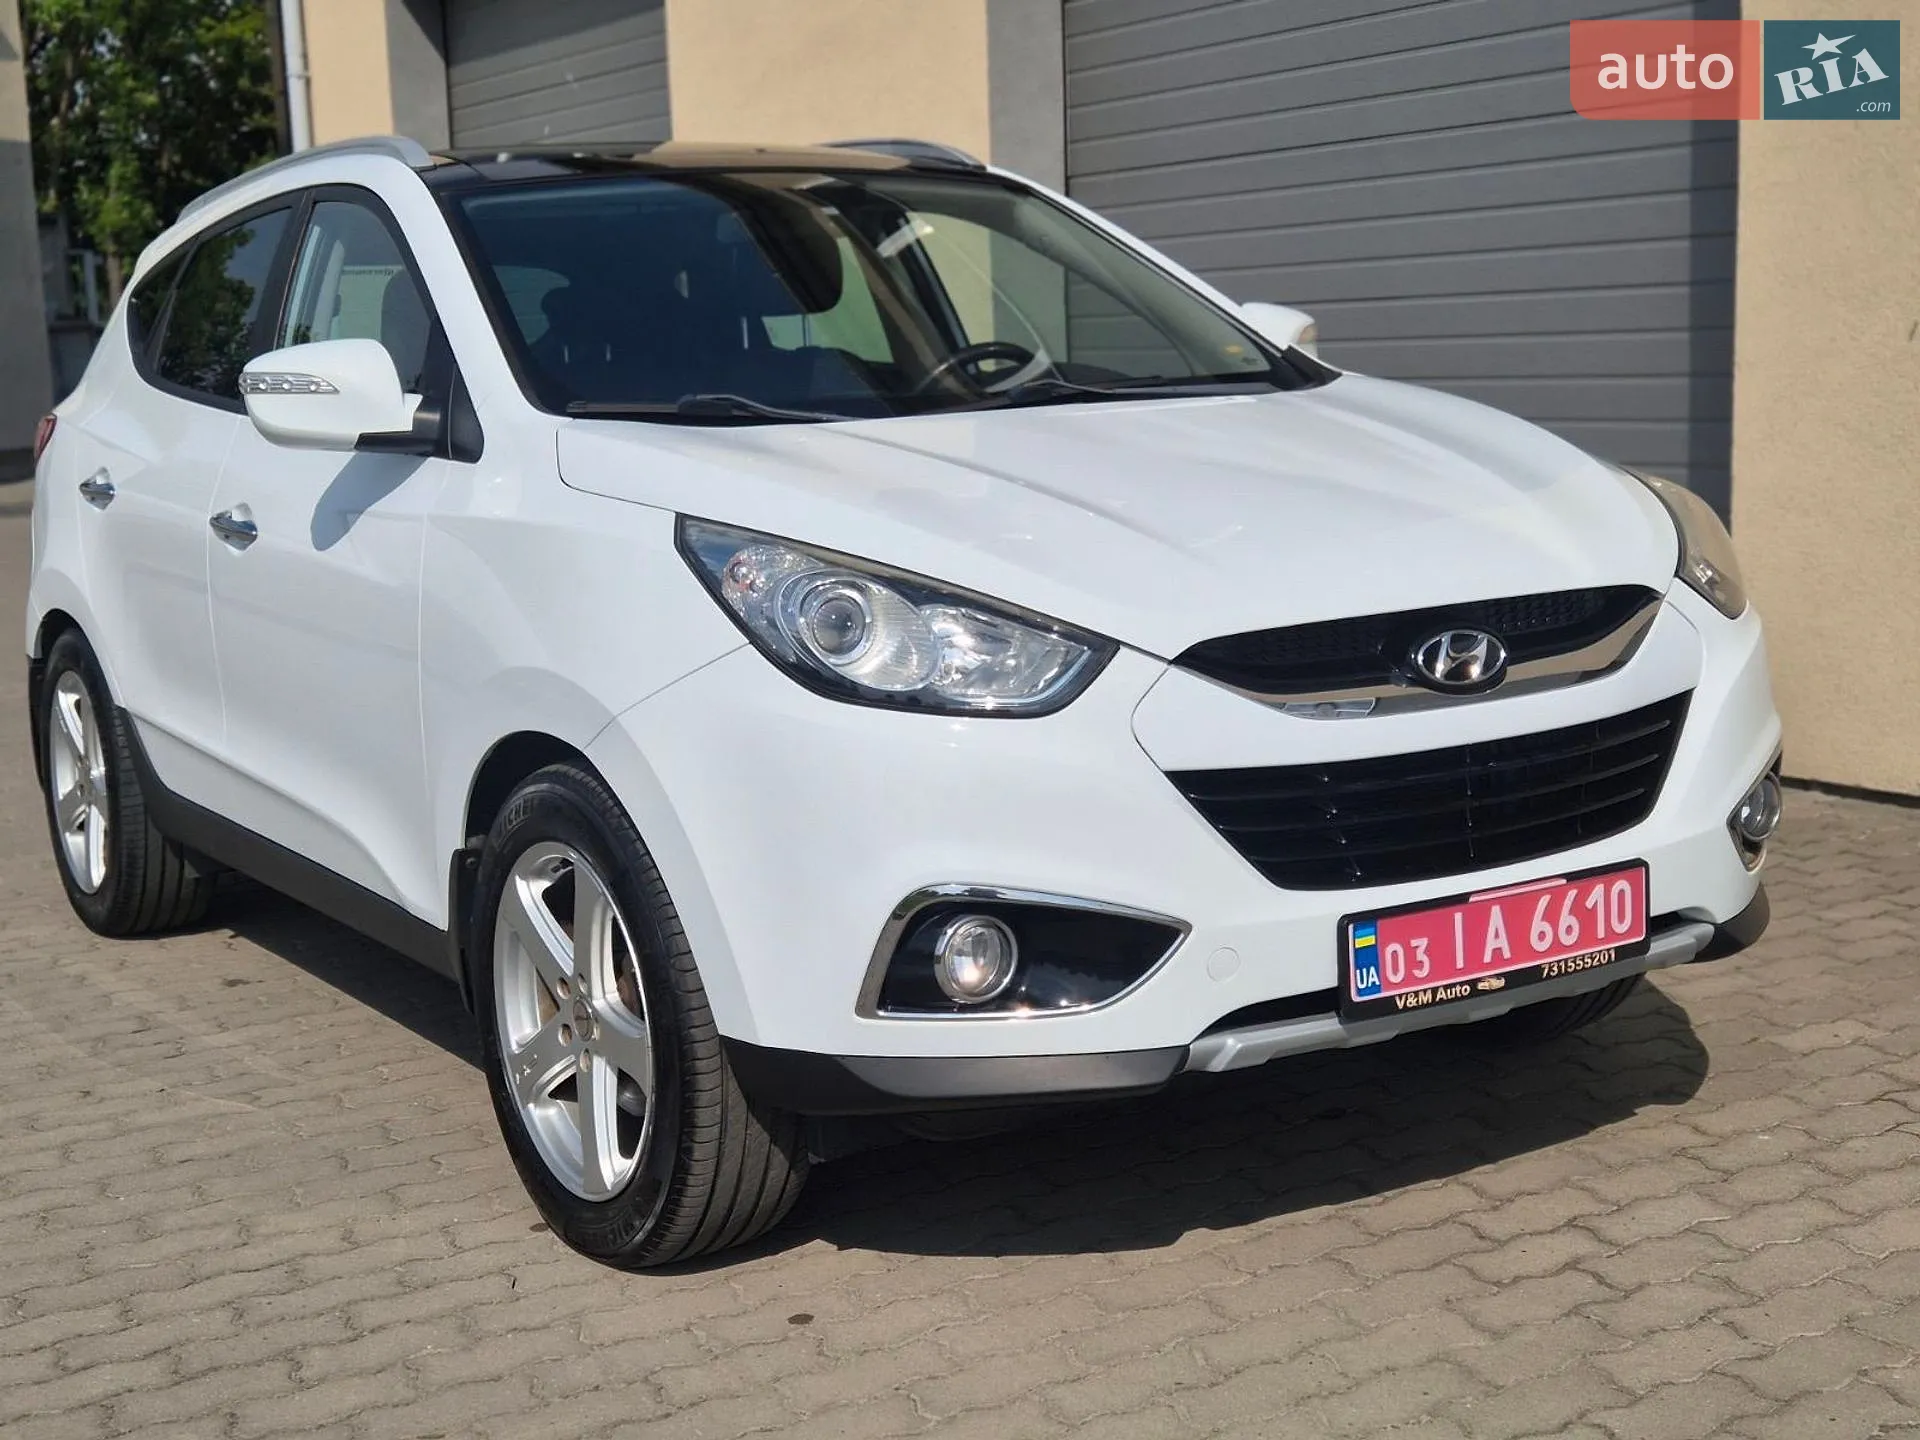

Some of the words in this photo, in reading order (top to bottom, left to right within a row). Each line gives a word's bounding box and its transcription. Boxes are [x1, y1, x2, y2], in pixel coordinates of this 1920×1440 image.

[1356, 966, 1380, 989] UA
[1385, 937, 1430, 984] 03
[1454, 905, 1512, 970] IA
[1529, 879, 1633, 953] 6610
[1395, 989, 1433, 1010] V&M
[1436, 984, 1471, 1002] Auto
[1541, 948, 1616, 979] 731555201
